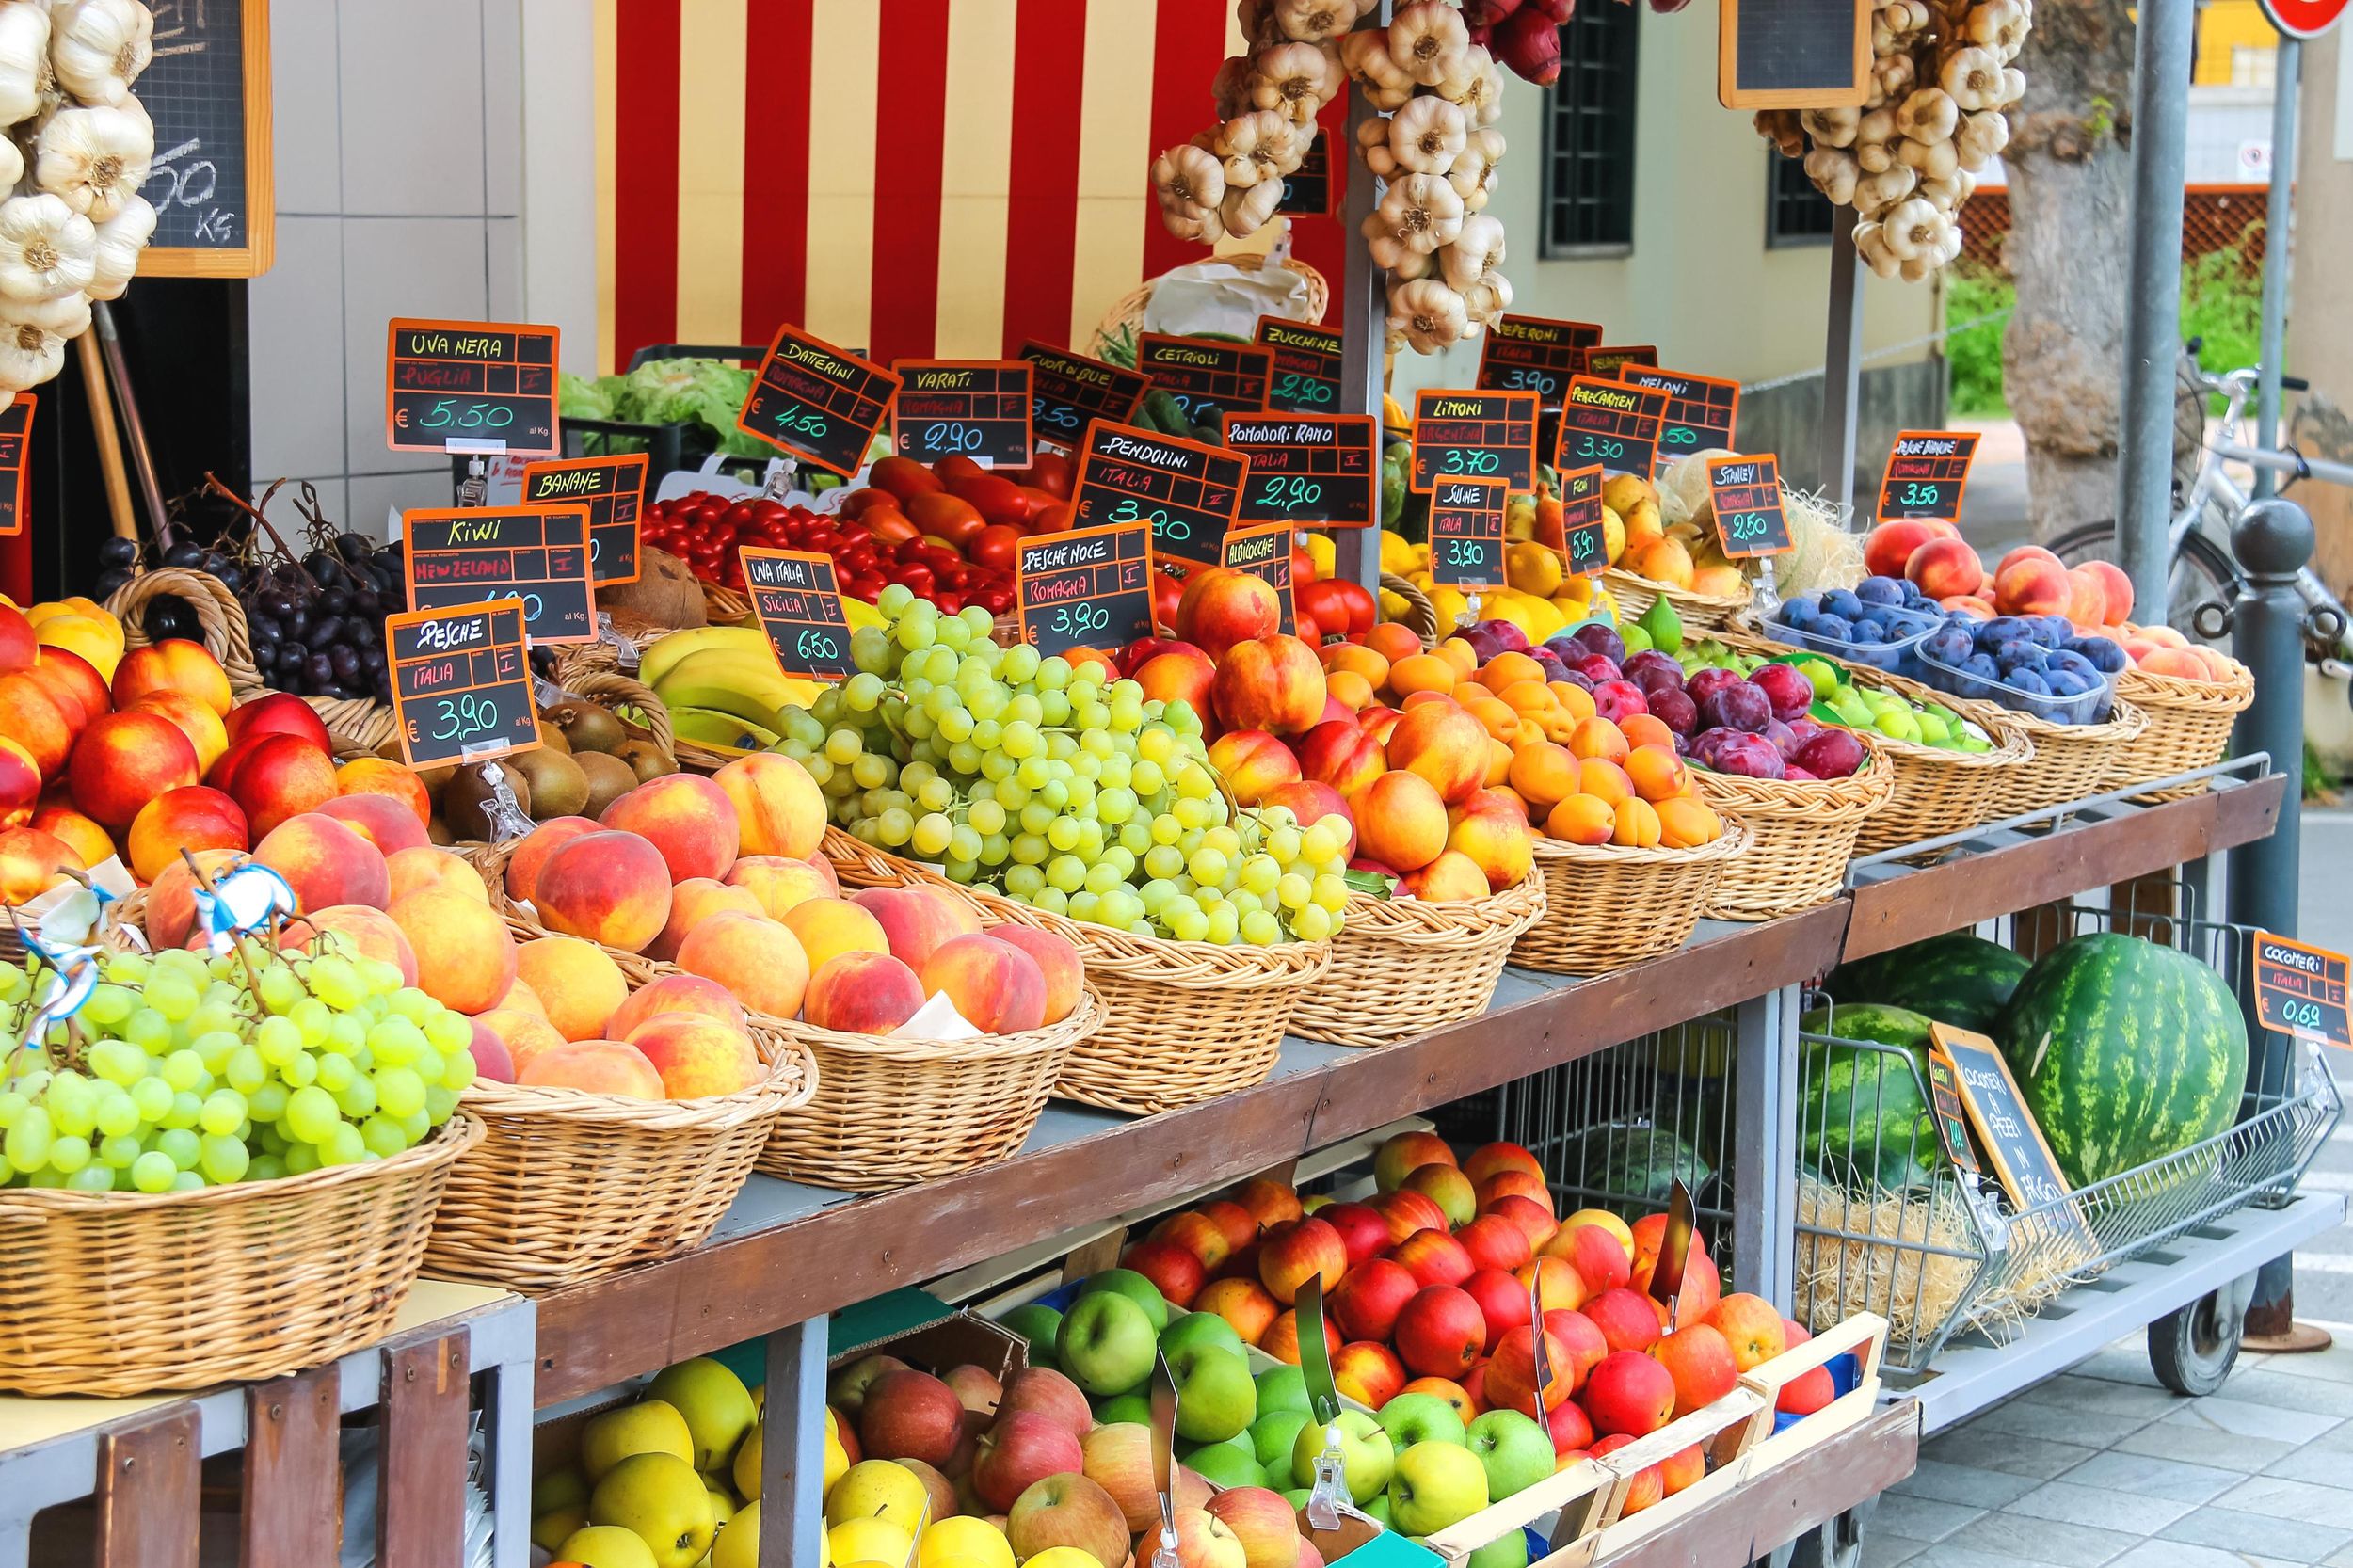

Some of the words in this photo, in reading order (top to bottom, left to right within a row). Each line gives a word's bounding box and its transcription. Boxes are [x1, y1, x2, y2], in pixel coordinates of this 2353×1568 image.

[411, 334, 448, 354] UVA
[455, 337, 502, 358] NERA
[777, 343, 856, 380] DATTERINI
[395, 408, 408, 428] €
[419, 399, 513, 427] 5,50
[751, 397, 764, 414] €
[775, 405, 827, 438] 4,50
[899, 433, 910, 449] €
[536, 472, 601, 497] BANANE
[1715, 464, 1754, 485] STANLEY
[1079, 500, 1093, 518] €
[1733, 512, 1767, 541] 2,50
[1021, 546, 1068, 571] PESCHE
[1070, 540, 1107, 564] NOCE
[1447, 540, 1484, 568] 3,90
[416, 619, 483, 649] PESCHE
[1027, 625, 1039, 645] €
[1051, 602, 1109, 639] 3,90
[797, 630, 838, 659] 6,50
[414, 663, 454, 689] ITALIA
[408, 720, 421, 743] €
[432, 694, 498, 741] 3,90
[2282, 1000, 2320, 1029] 0,69
[1988, 1092, 2002, 1114] A
